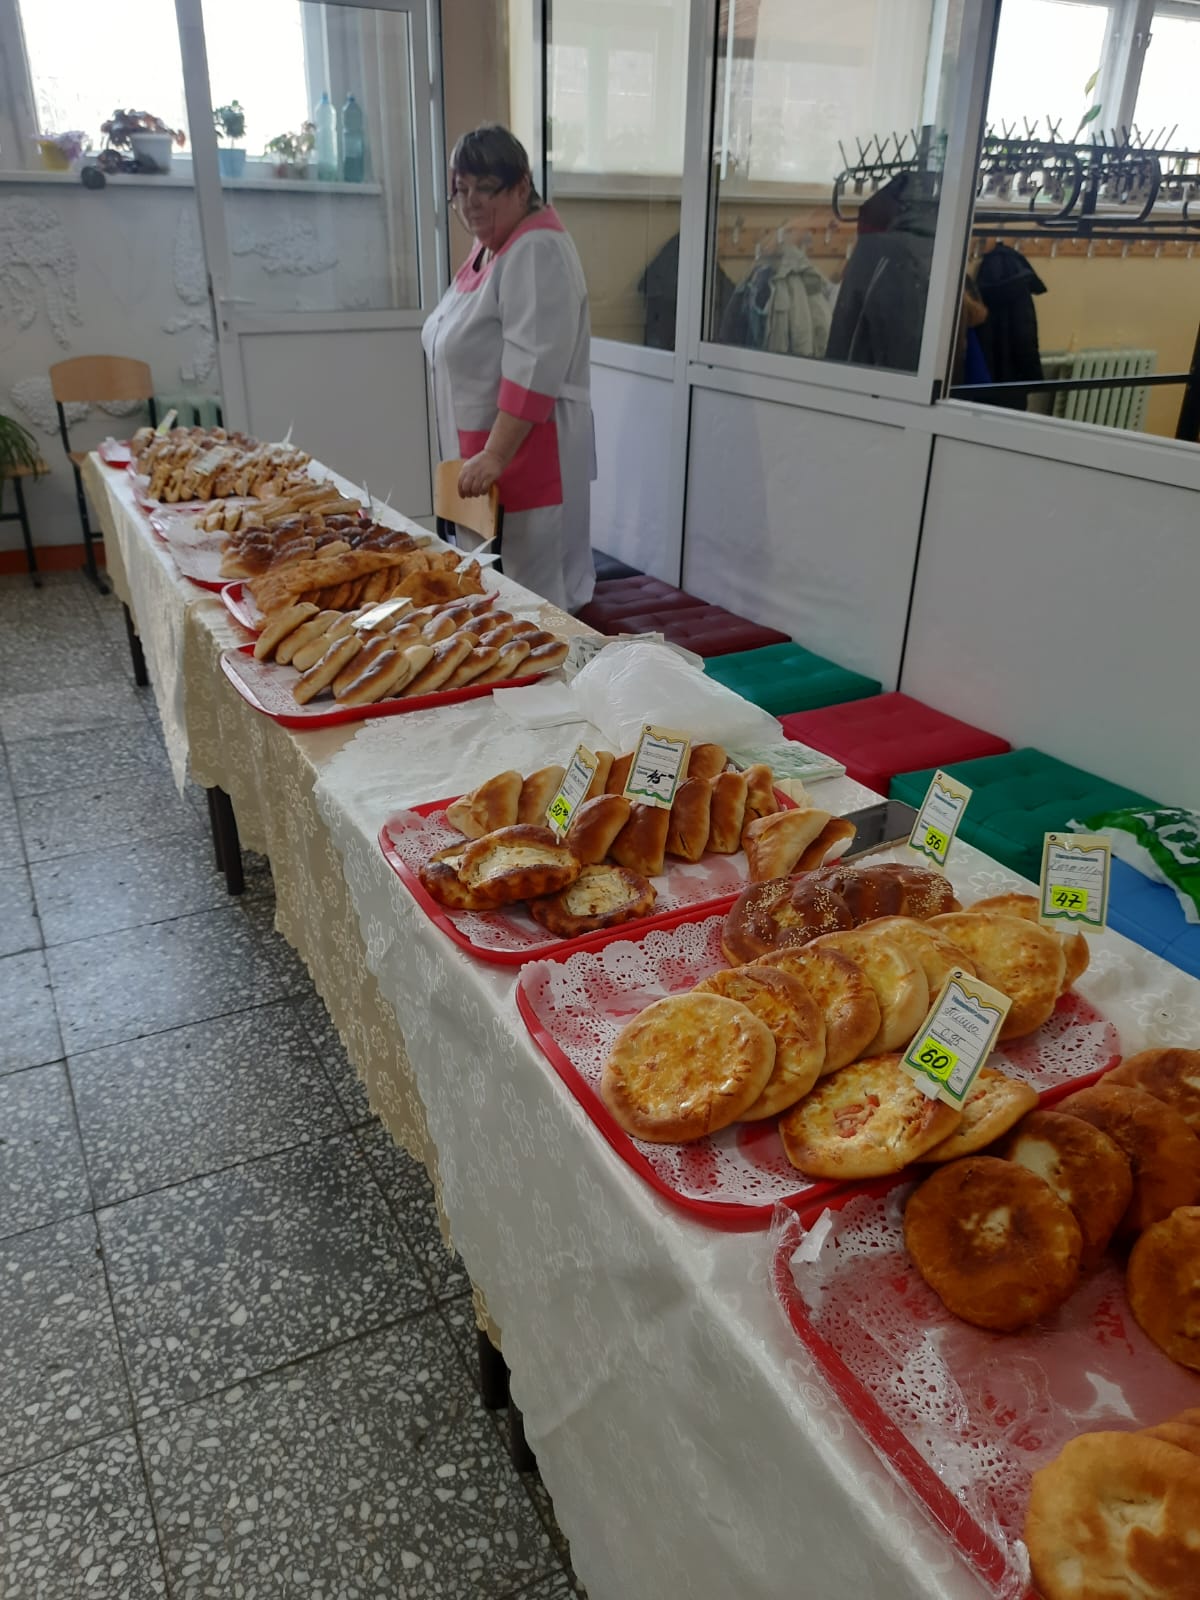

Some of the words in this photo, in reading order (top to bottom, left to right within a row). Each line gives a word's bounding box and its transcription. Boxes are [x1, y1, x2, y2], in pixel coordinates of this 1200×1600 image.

[926, 834, 942, 850] 56
[1055, 892, 1082, 908] 47
[920, 1049, 949, 1070] 60
